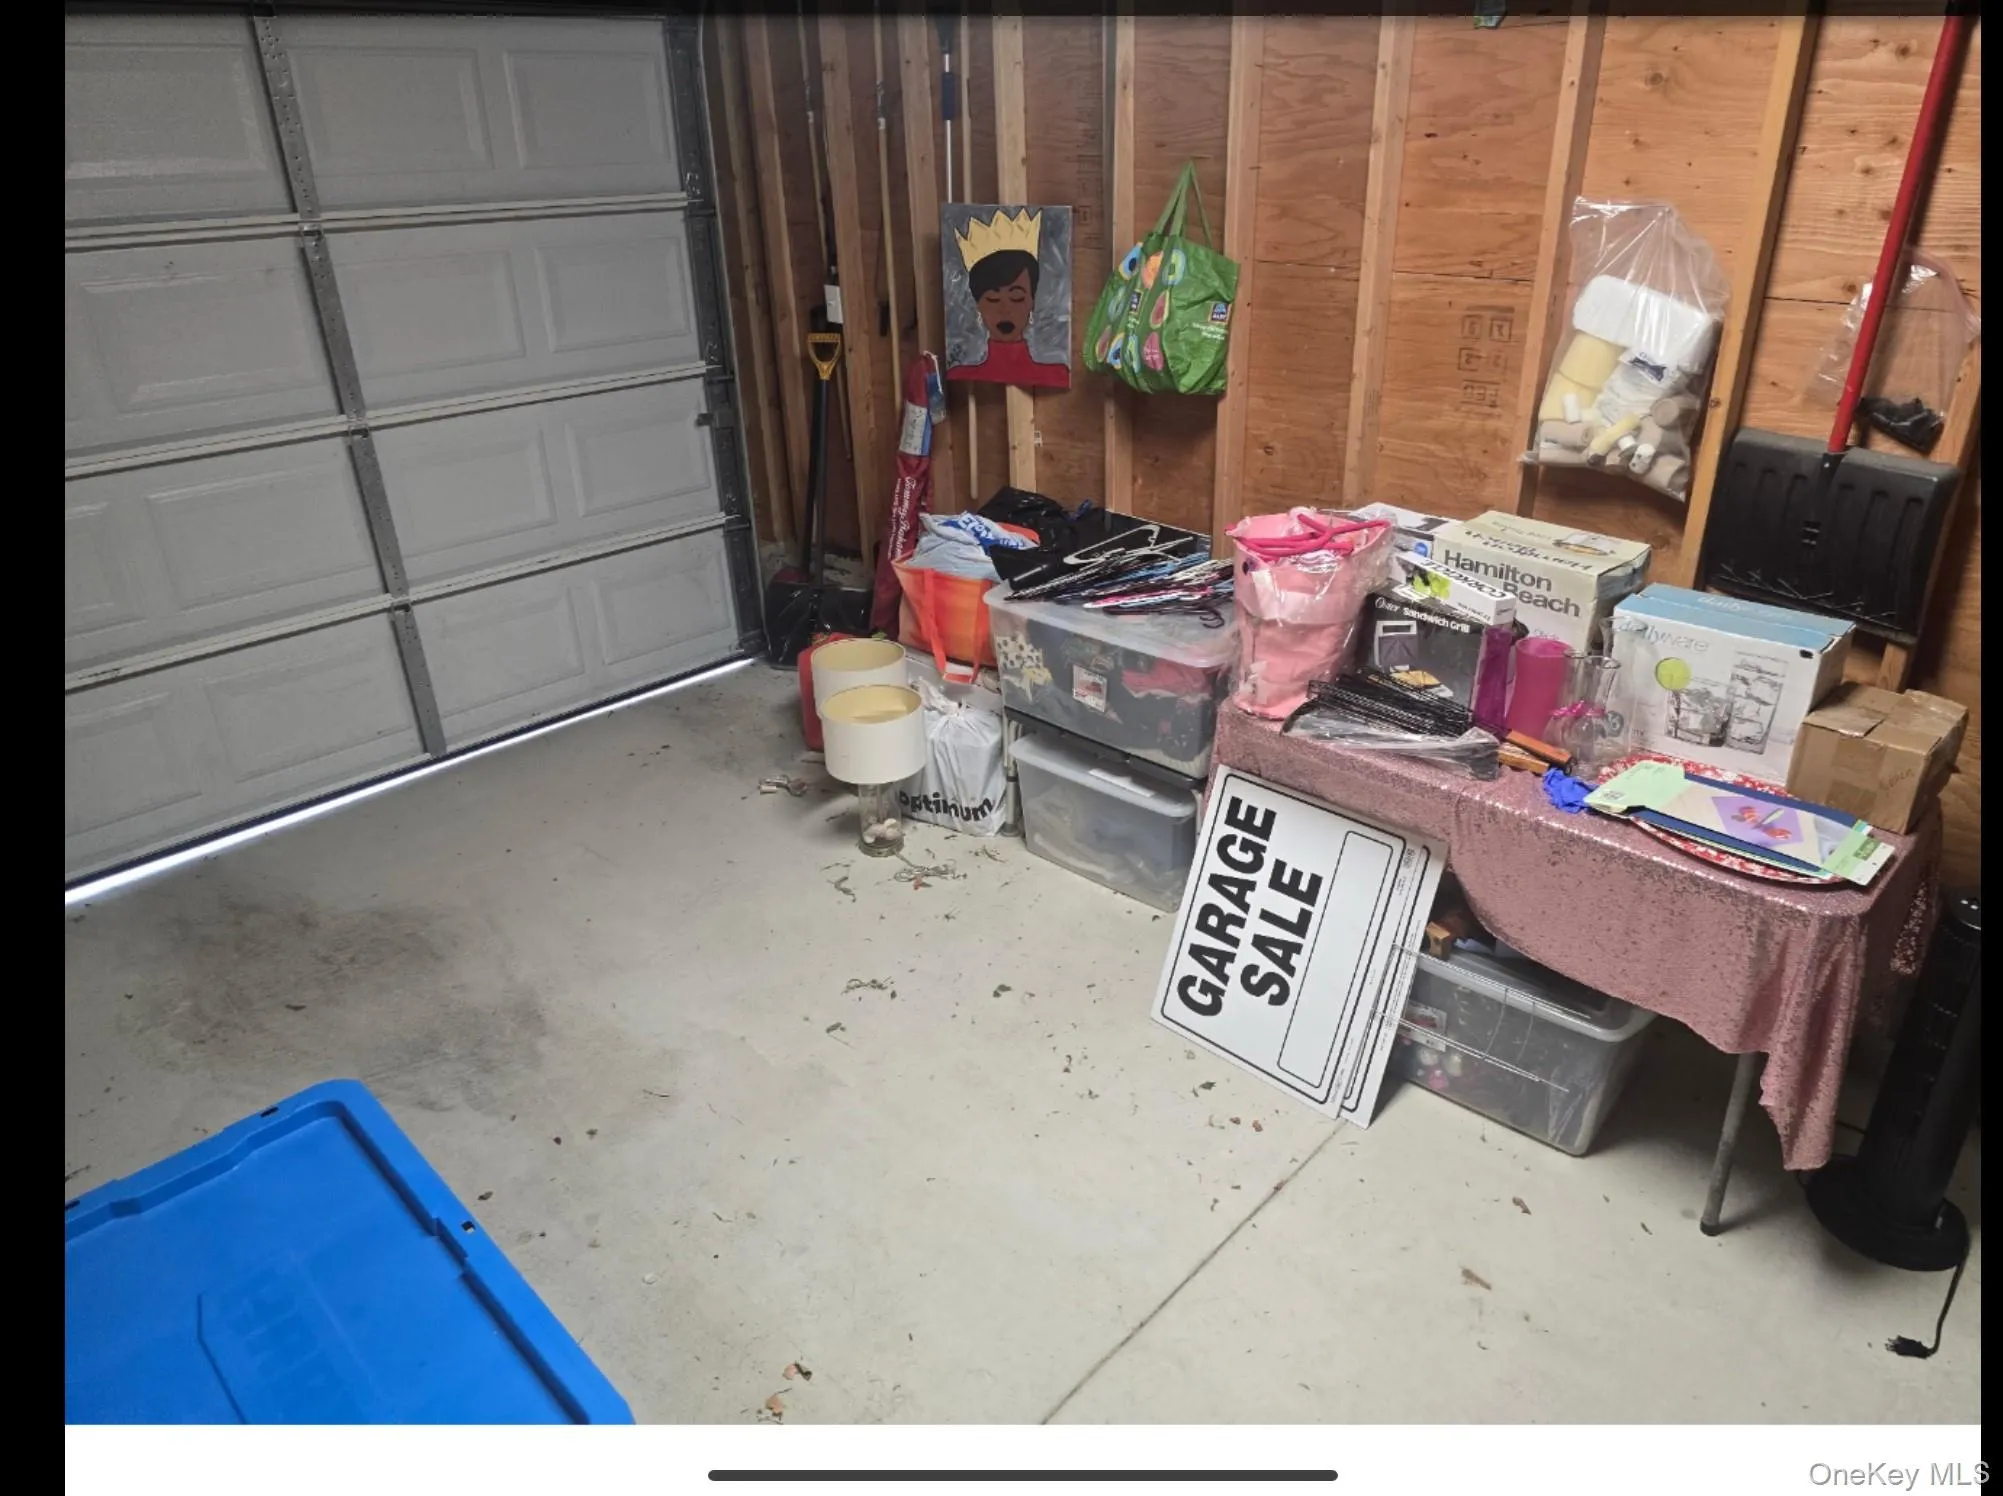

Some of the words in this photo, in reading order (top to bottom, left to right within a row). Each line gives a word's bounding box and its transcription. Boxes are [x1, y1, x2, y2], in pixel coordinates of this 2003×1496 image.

[1444, 549, 1553, 592] Hamilton
[1503, 583, 1581, 618] Beach
[898, 790, 993, 821] optimum
[1176, 795, 1277, 1017] GARAGE
[1240, 860, 1323, 1006] SALE
